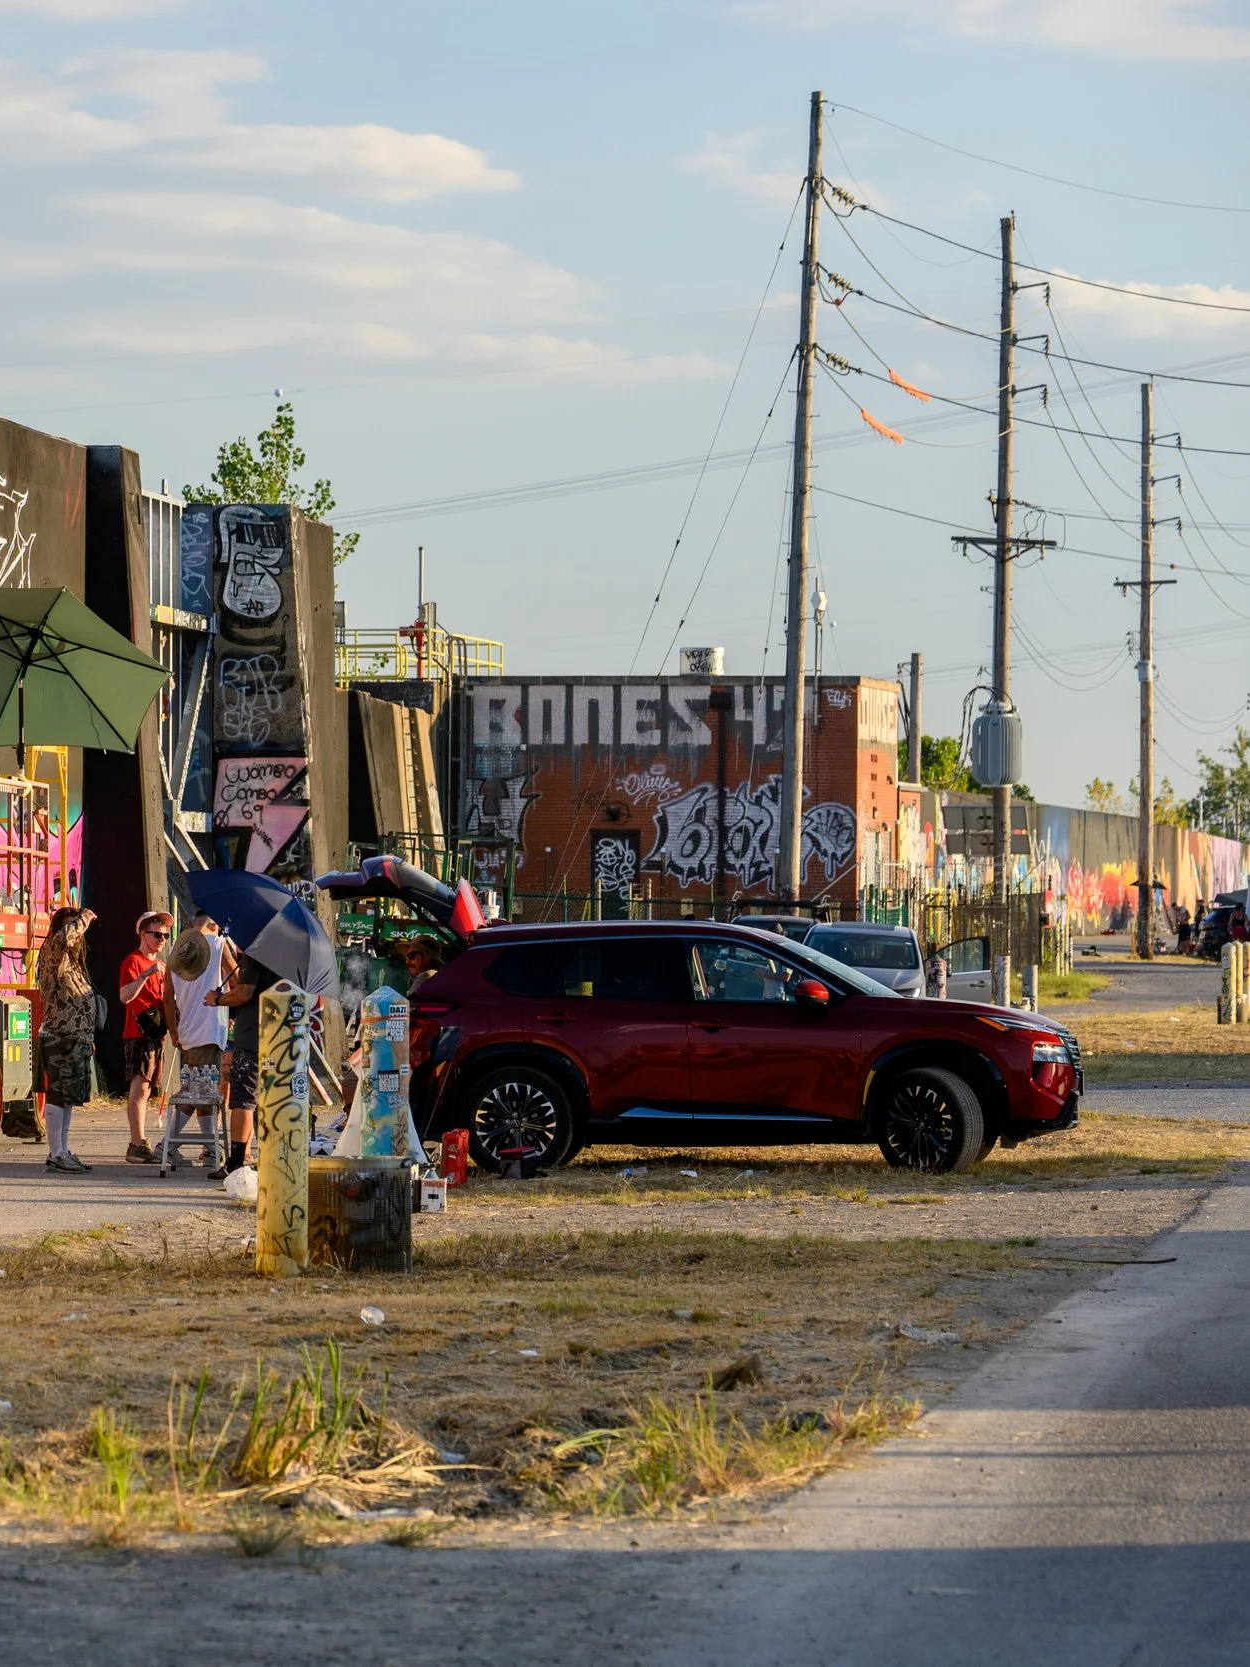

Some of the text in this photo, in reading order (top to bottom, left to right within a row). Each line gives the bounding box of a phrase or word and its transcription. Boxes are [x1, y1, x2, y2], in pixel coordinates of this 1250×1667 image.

[473, 684, 712, 747] BONES
[241, 801, 264, 826] 69
[339, 920, 374, 930] SKYJAC
[390, 1006, 407, 1014] DAZE
[385, 1020, 405, 1028] MOXIE
[385, 1028, 405, 1037] PUCK
